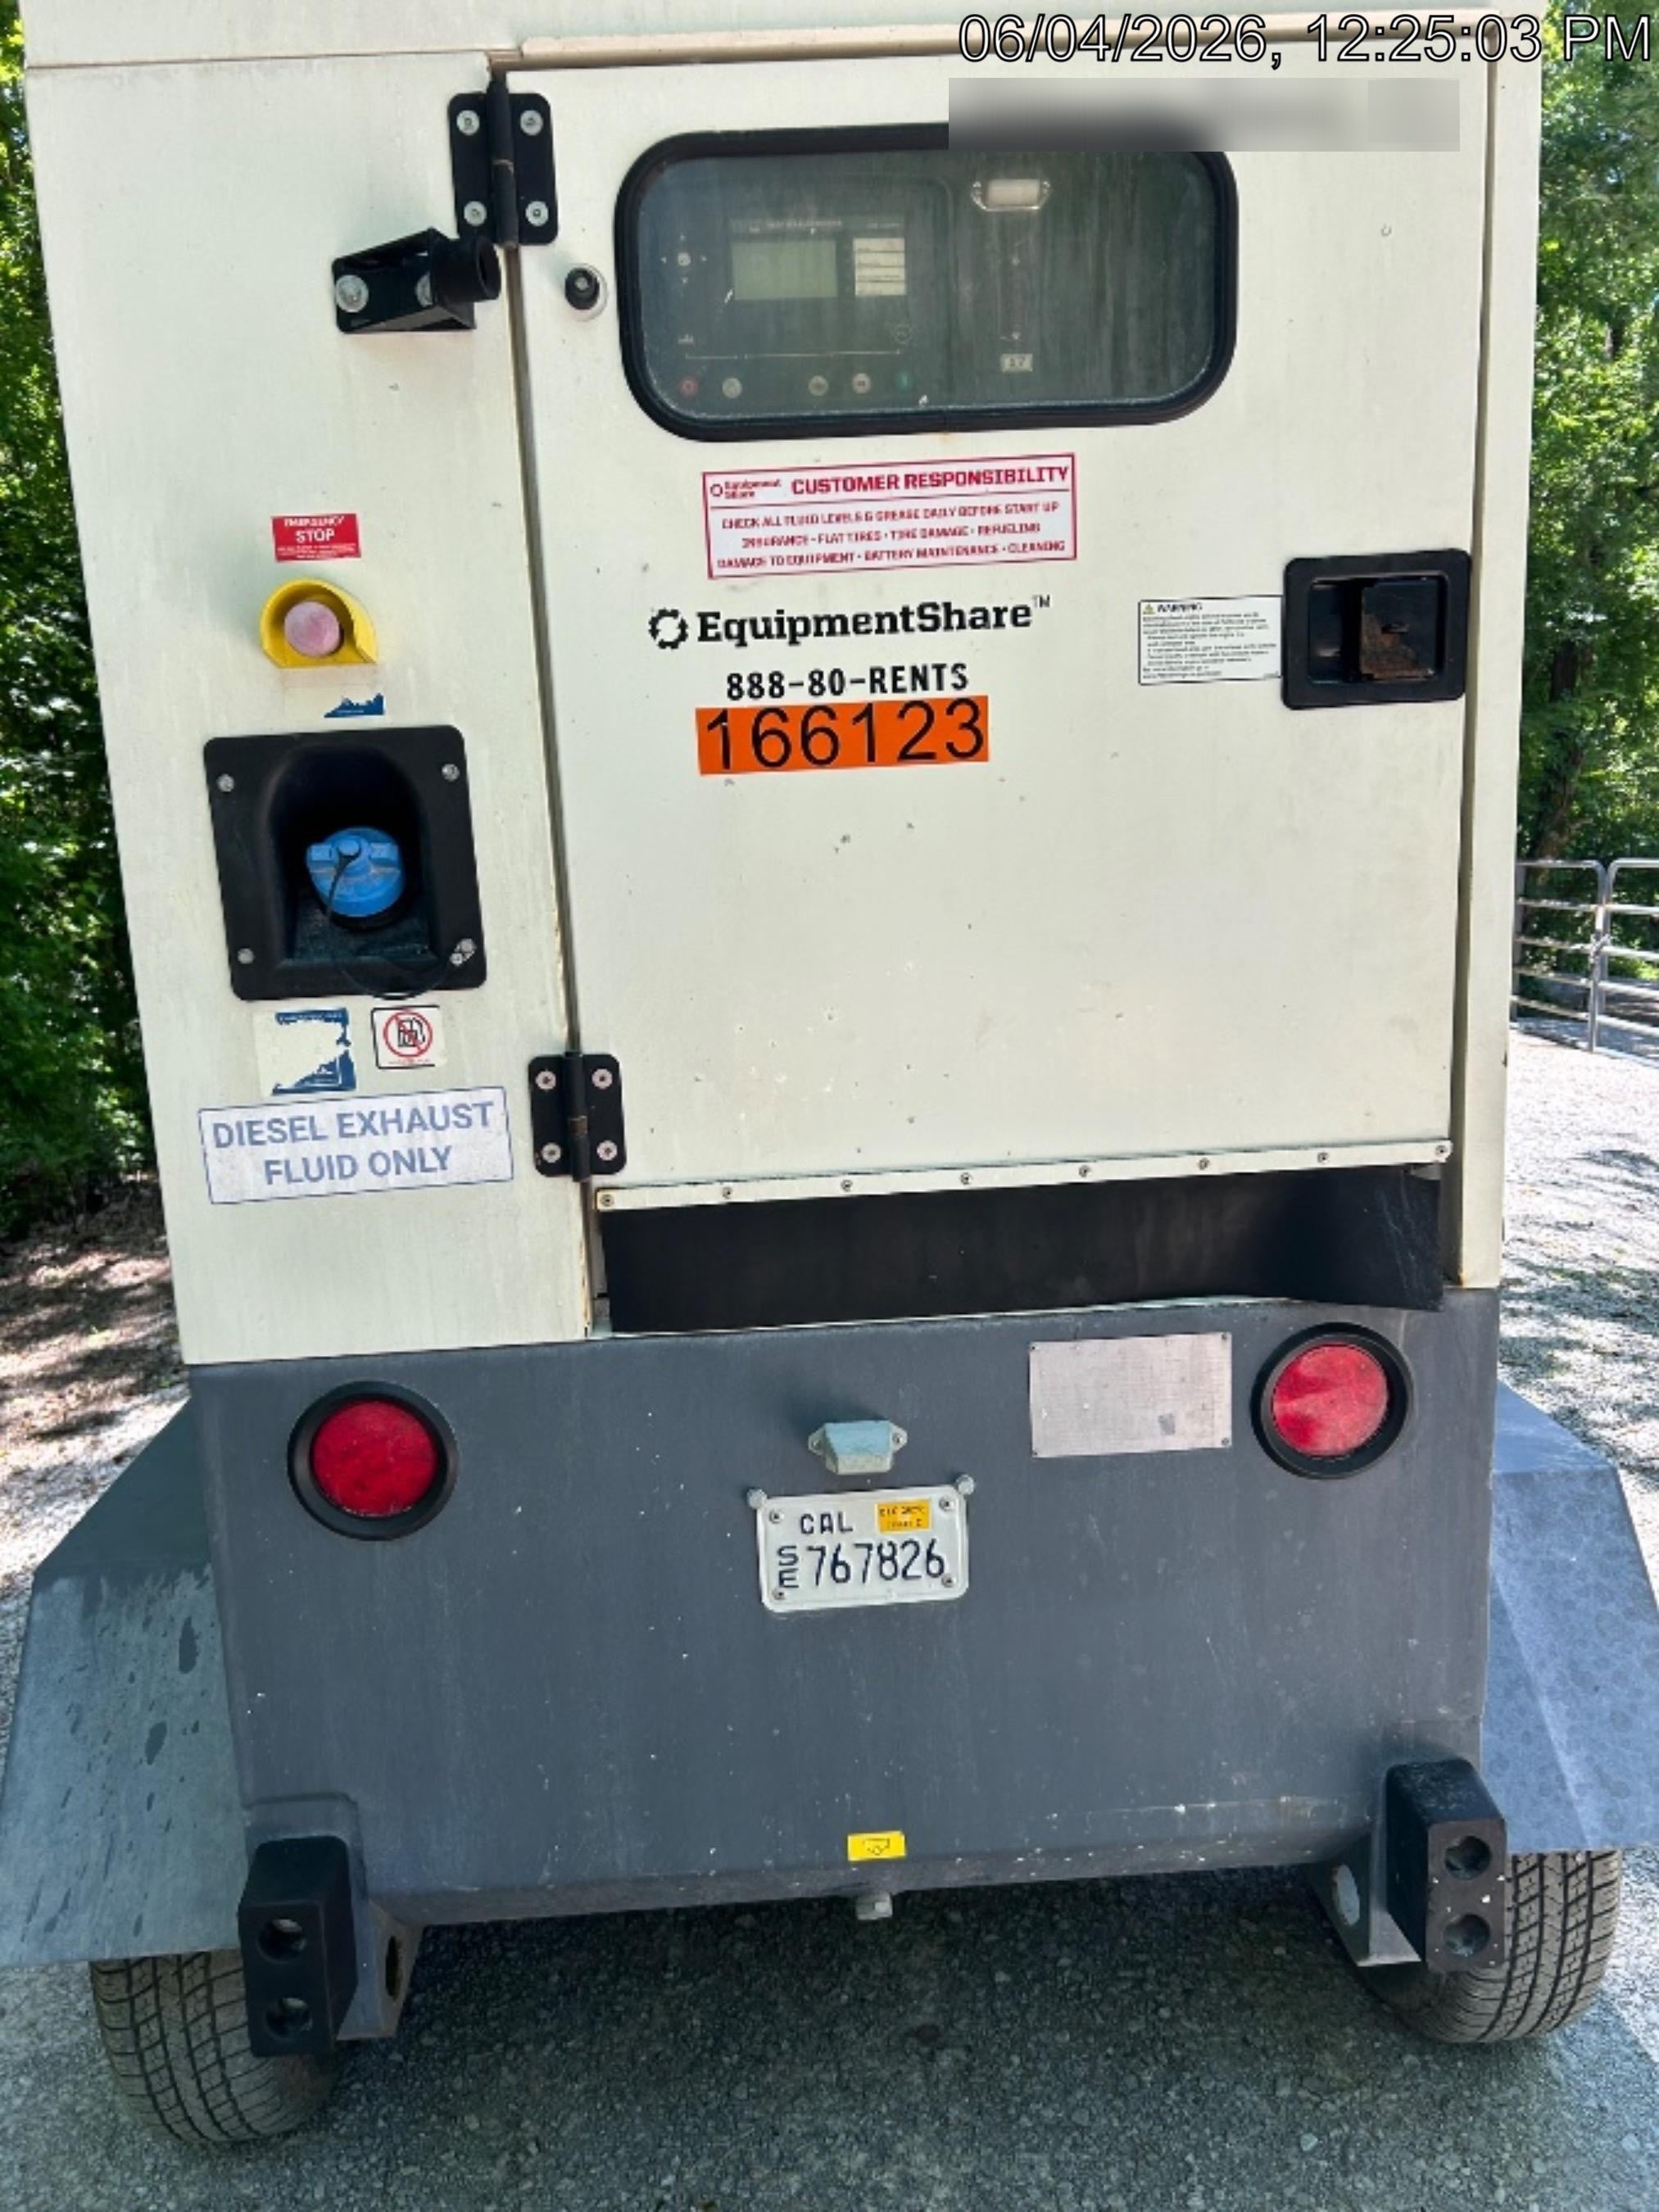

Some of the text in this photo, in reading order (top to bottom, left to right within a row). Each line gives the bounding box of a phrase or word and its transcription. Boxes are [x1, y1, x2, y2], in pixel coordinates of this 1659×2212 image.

[791, 466, 1068, 495] CUSTOMER RESPONSIBILITY
[722, 518, 759, 529] CHECK
[762, 515, 782, 527] ALL
[784, 514, 819, 526] FLUID
[821, 511, 861, 524] LEVELS
[875, 508, 919, 521] GREASE
[923, 506, 957, 519] DAILY
[959, 505, 1000, 518] BEFORE
[1004, 502, 1040, 514] START
[1043, 501, 1060, 512] UP
[296, 528, 335, 543] STOP
[818, 533, 845, 544] FLAT
[847, 531, 881, 542] TIRES
[891, 529, 917, 541] TIRE
[920, 525, 969, 539] DAMAGE
[978, 523, 1040, 537] REFUELING
[718, 541, 1065, 569] DAMAGE TO EQUIPMENT BATTERY MAINTENANCE CLEANING
[697, 601, 1032, 647] EquipmentShare
[727, 662, 968, 700] 888-80-RENTS
[706, 697, 984, 770] 166123
[212, 1101, 494, 1149] DIESEL EXHAUST
[264, 1145, 452, 1185] FLUID ONLY
[800, 1512, 853, 1534] CAL
[806, 1538, 945, 1587] 767826
